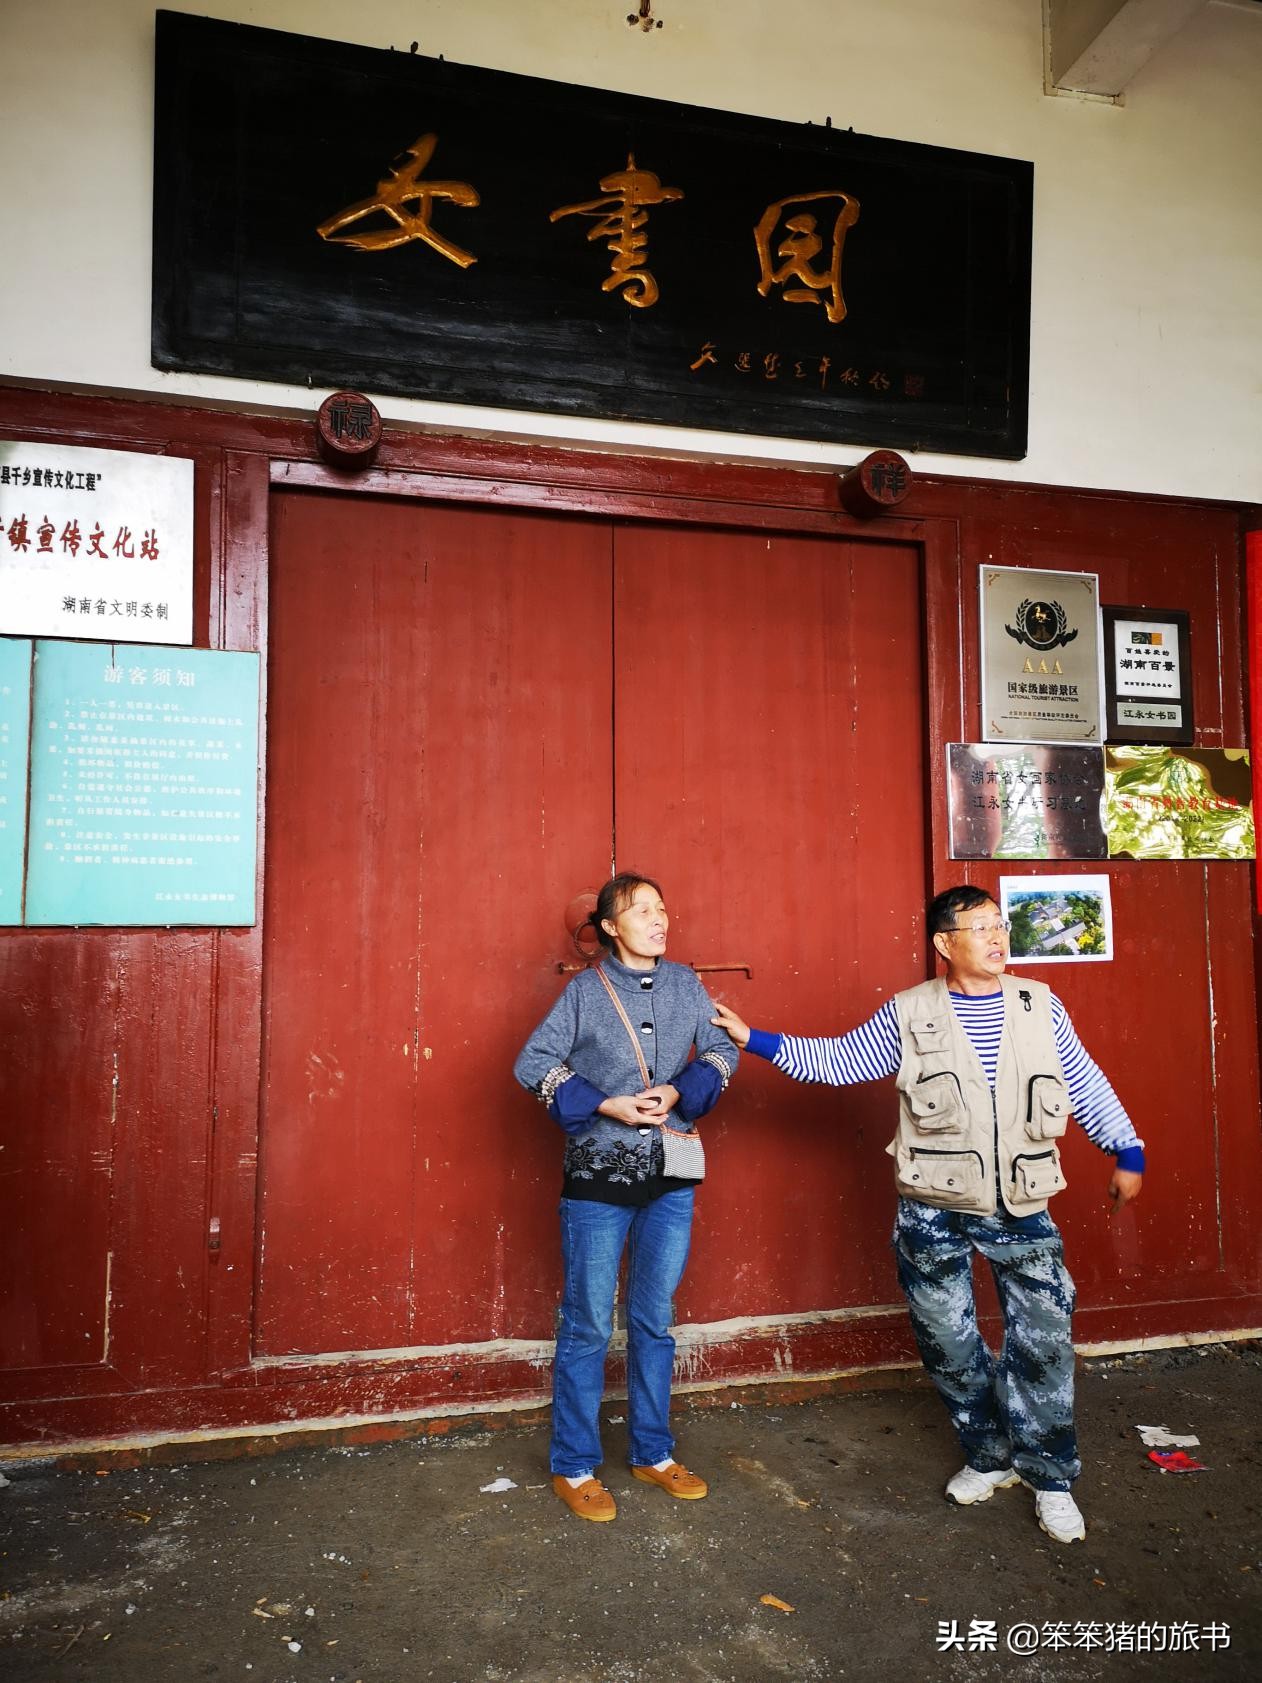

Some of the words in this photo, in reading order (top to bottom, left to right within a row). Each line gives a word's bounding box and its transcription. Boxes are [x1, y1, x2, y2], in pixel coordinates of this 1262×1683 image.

[0, 465, 102, 491] 县千乡宣传文化工程”
[0, 513, 161, 560] 镇宣传文化站
[62, 595, 169, 620] 湖南省文明委制
[103, 665, 196, 687] 游客须知
[1120, 659, 1176, 672] 湖南百景
[1007, 682, 1079, 696] 国家级旅游景区
[1123, 709, 1177, 720] 江永女书园
